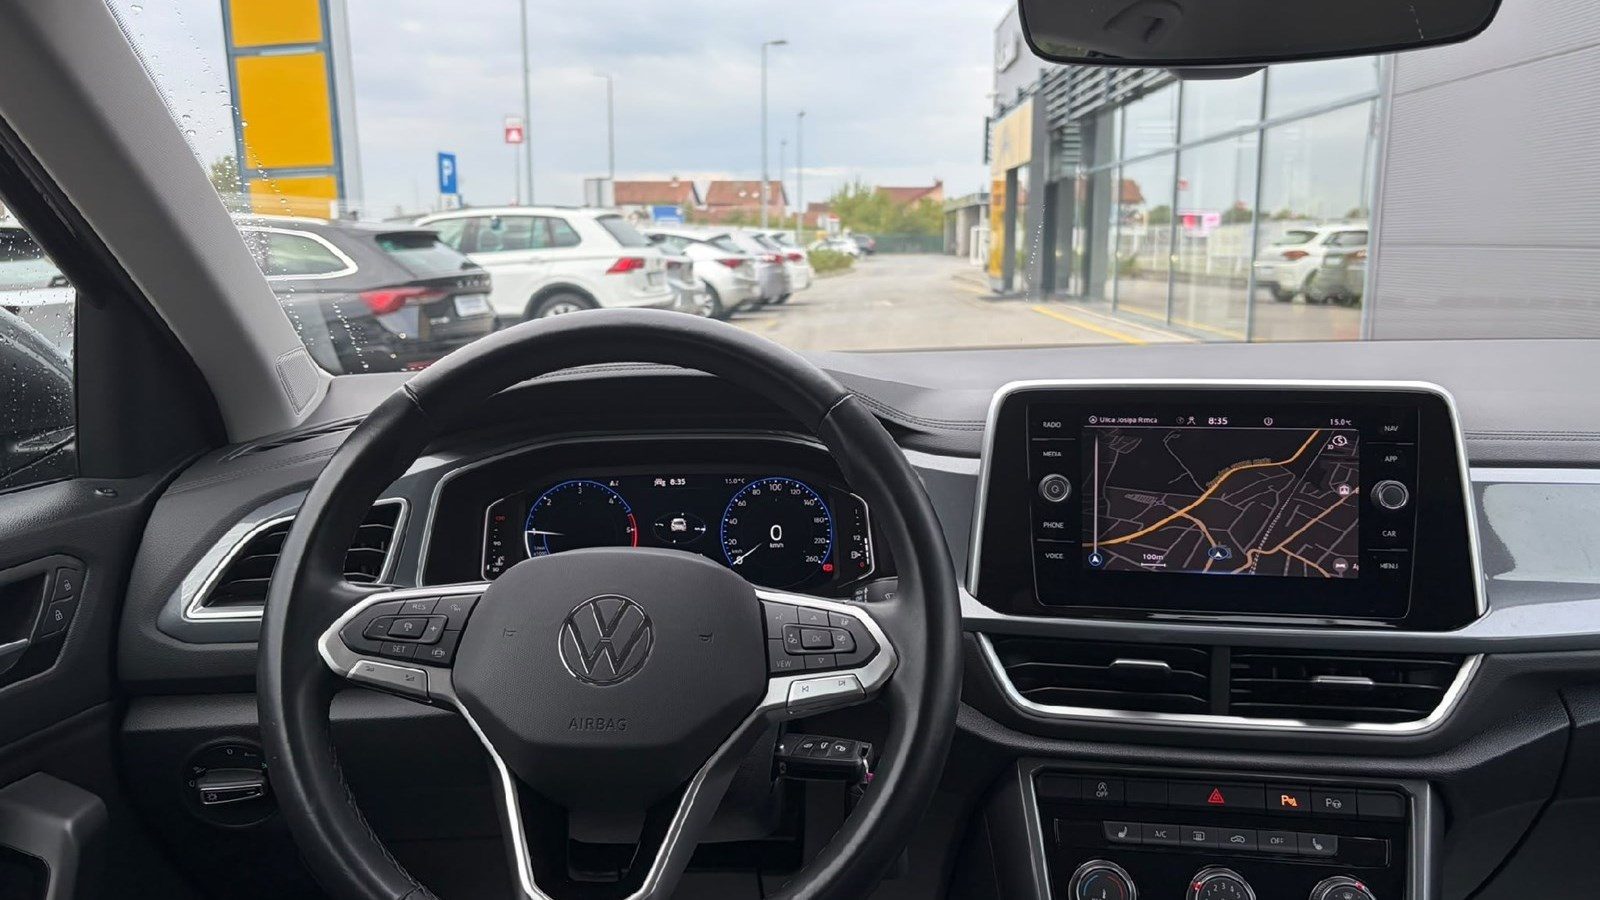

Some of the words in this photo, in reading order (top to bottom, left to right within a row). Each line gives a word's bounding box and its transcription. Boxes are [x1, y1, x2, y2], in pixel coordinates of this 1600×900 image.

[1208, 416, 1228, 425] 8:35
[1042, 421, 1062, 429] RADIO
[669, 478, 686, 486] 8:35
[769, 483, 783, 492] 100
[546, 498, 552, 506] 2
[1043, 521, 1064, 529] PHONE
[770, 524, 783, 541] 0
[728, 538, 738, 546] 20
[805, 555, 819, 563] 260
[392, 645, 406, 654] SET
[776, 660, 792, 669] VEW
[568, 717, 628, 732] AIRBAG
[1213, 884, 1219, 892] 2
[1221, 882, 1227, 890] 3
[1229, 885, 1235, 893] 4
